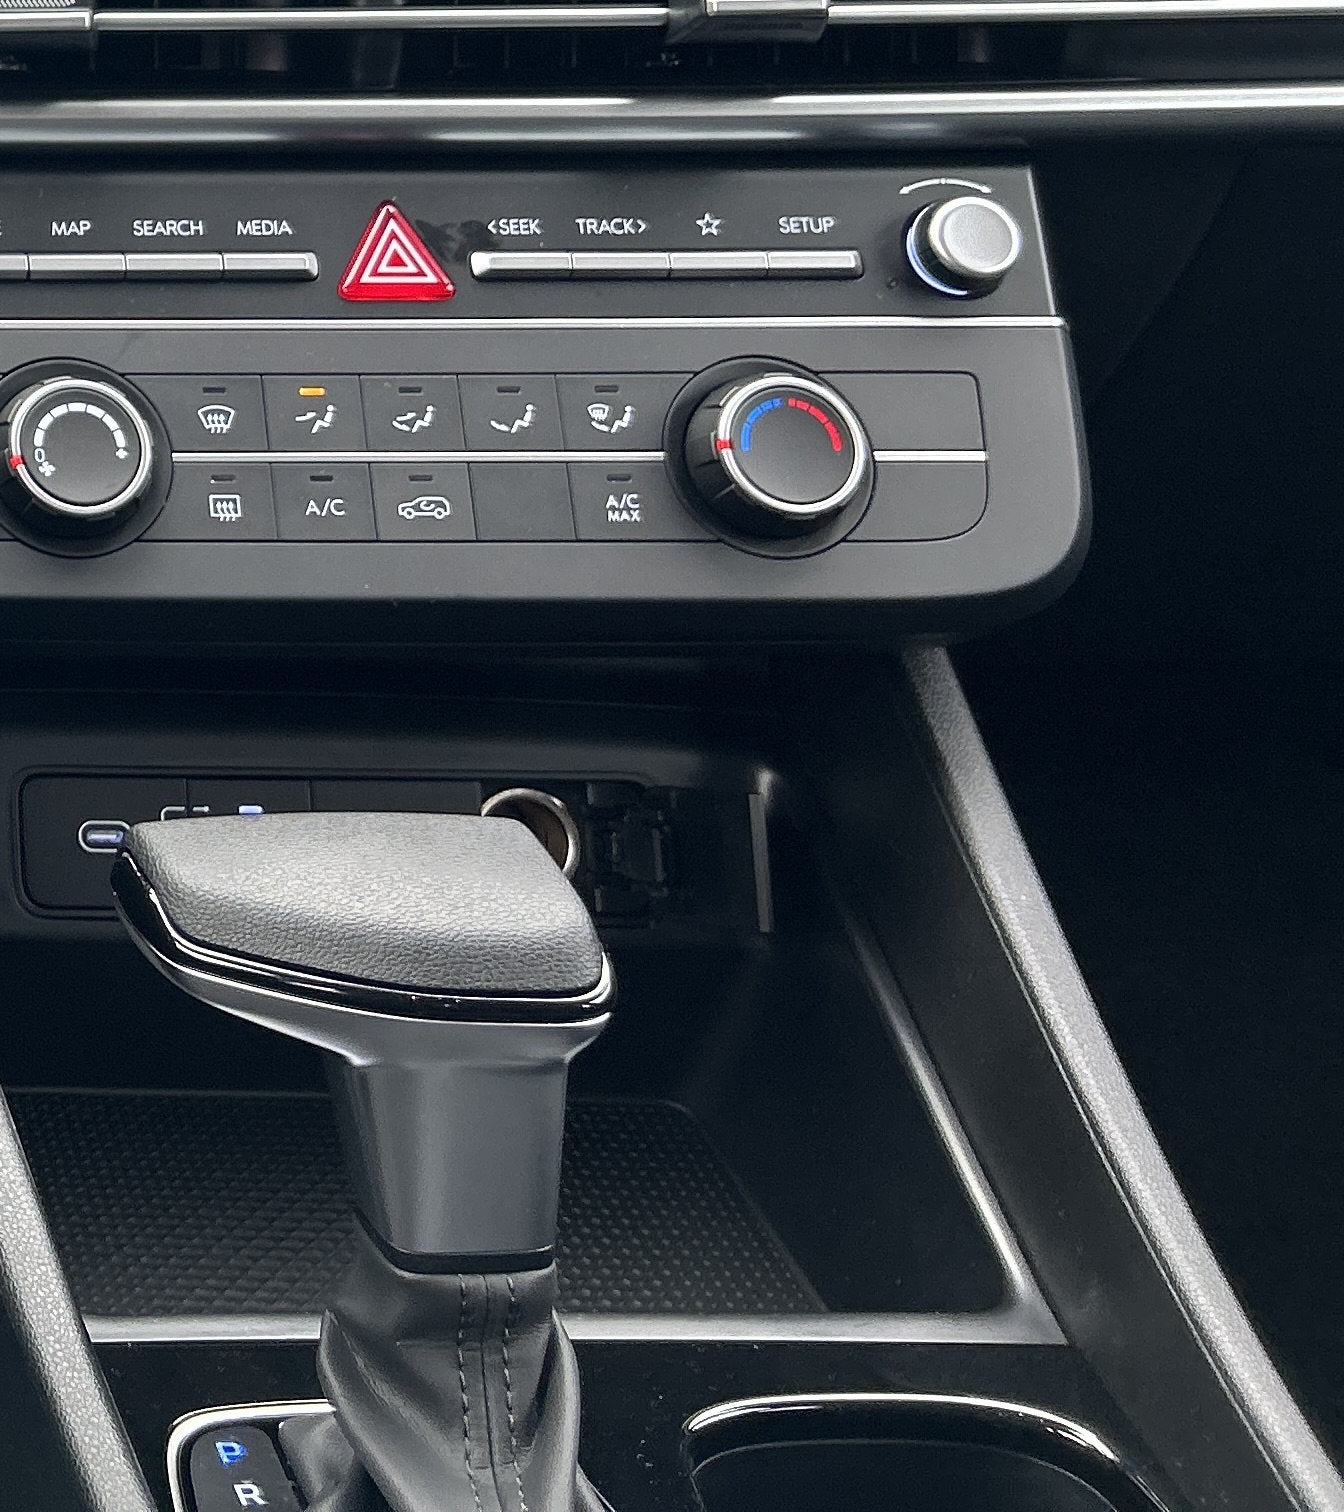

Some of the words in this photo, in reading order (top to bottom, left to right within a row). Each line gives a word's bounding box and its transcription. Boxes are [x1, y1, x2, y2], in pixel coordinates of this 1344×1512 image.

[50, 220, 91, 237] MAP
[132, 219, 204, 237] SEARCH
[236, 219, 293, 237] MEDIA
[498, 217, 541, 236] SEEK
[574, 217, 637, 236] TRACK
[778, 216, 836, 234] SETUP
[305, 499, 346, 517] A/C
[605, 494, 639, 510] A/C
[607, 509, 641, 523] MAX
[215, 1441, 247, 1467] P
[232, 1482, 268, 1507] R
